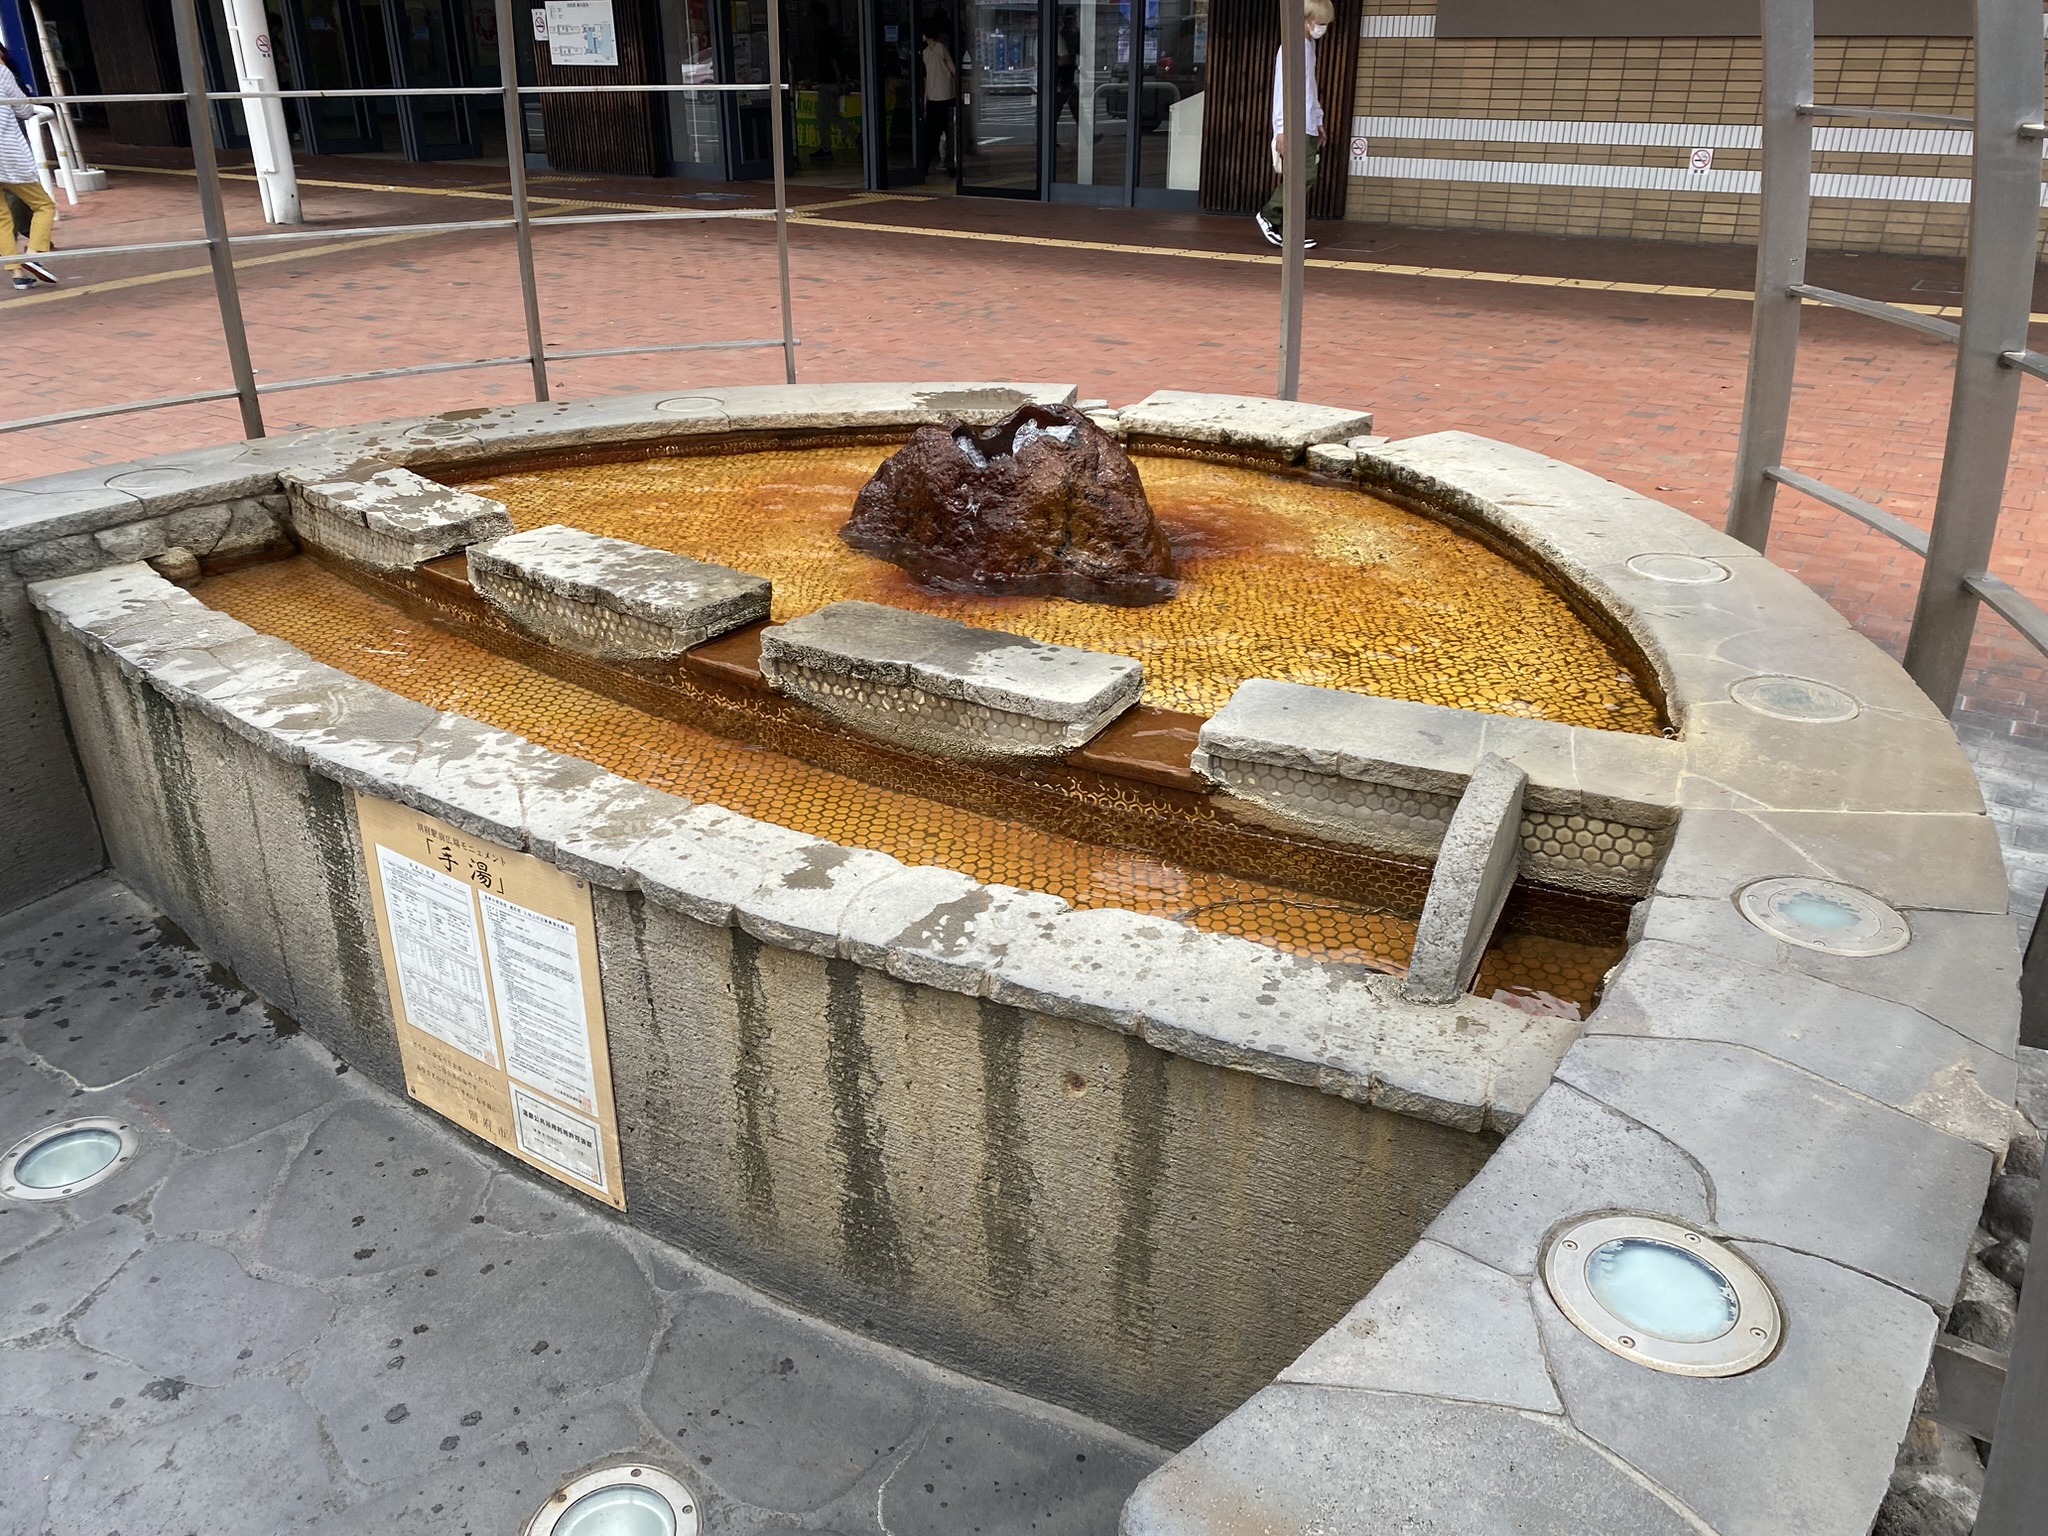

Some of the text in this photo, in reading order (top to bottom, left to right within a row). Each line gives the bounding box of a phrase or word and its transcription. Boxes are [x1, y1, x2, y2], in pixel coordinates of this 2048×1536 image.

[416, 822, 506, 868] 別府駅前広場モニュメント
[426, 837, 505, 895] 「手湯」
